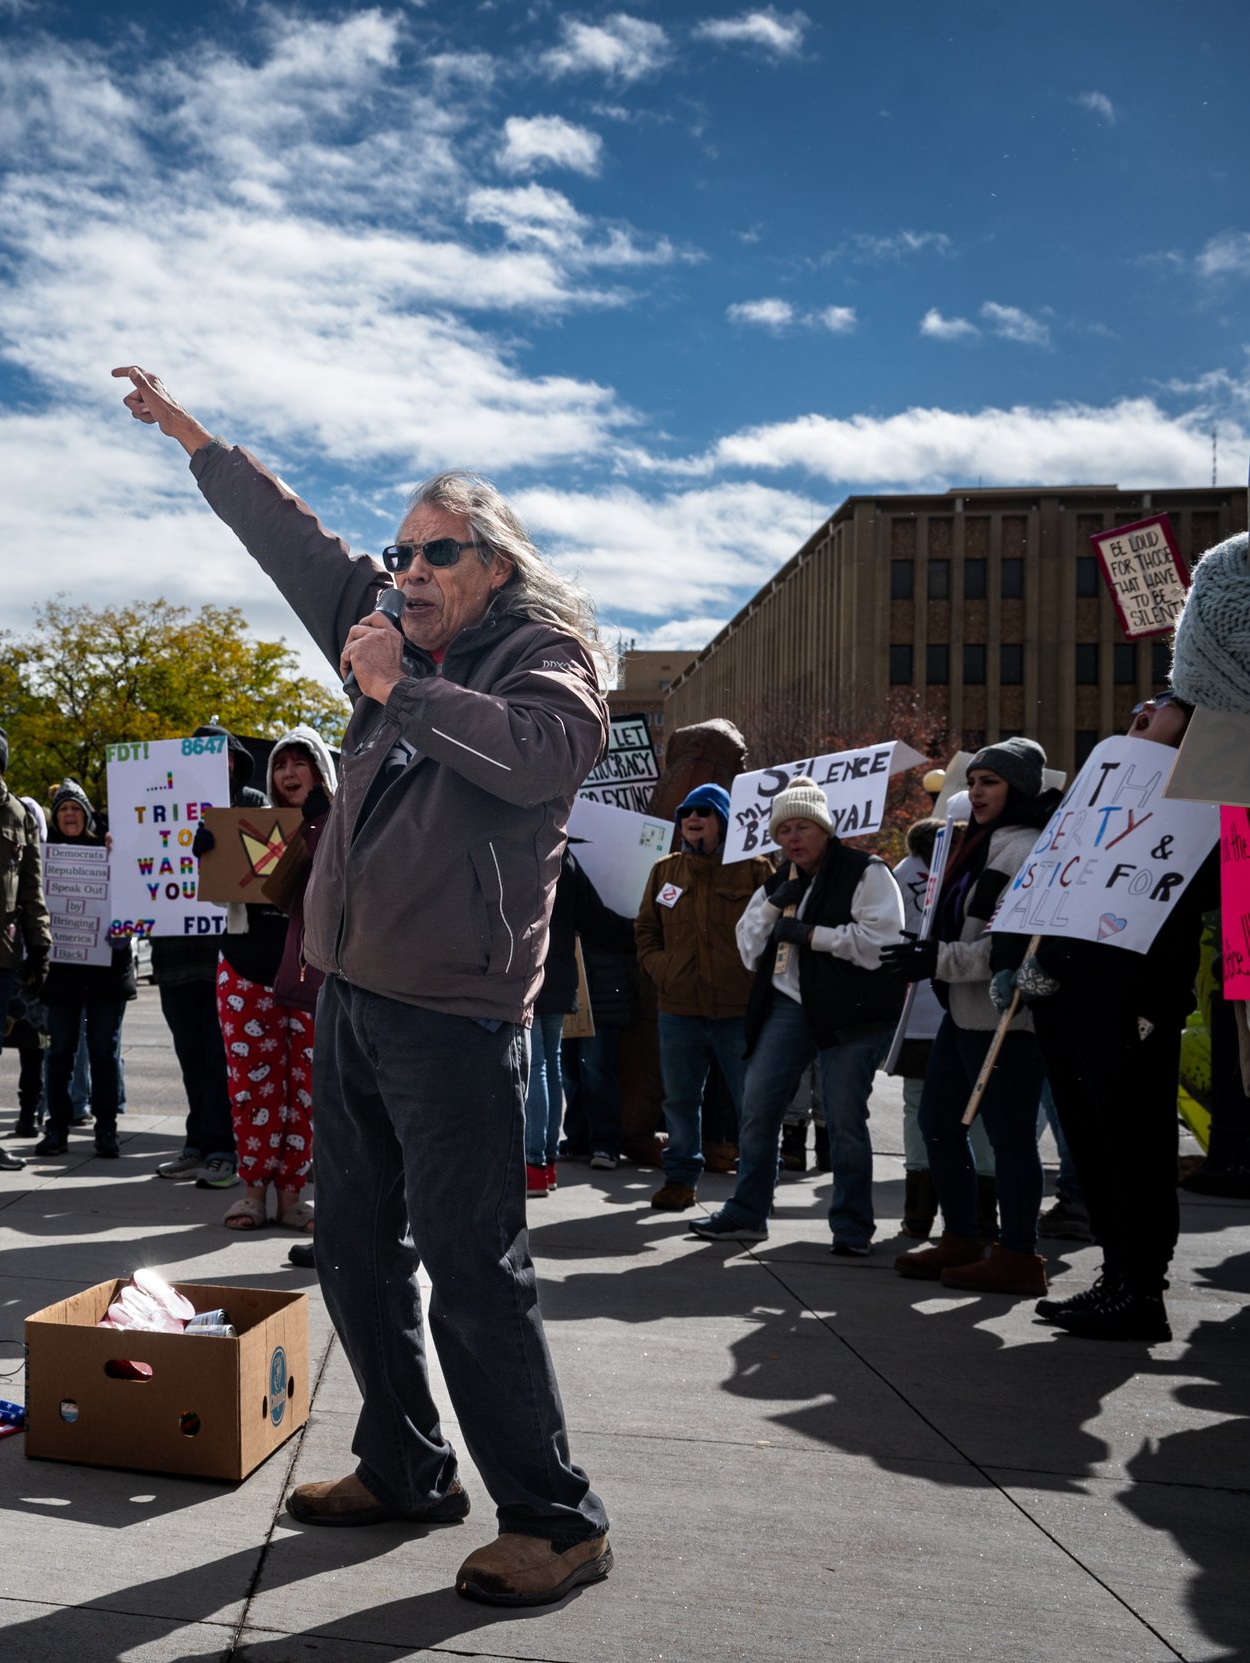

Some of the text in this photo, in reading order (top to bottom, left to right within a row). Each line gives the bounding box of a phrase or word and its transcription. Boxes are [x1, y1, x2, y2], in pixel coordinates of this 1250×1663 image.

[1109, 531, 1159, 558] BE LOUD
[1110, 546, 1174, 578] FOR THOSE
[1112, 567, 1178, 595] THAT HAVE
[1129, 588, 1171, 609] TO BE
[612, 725, 644, 749] LET
[106, 735, 227, 762] FDT! 8647
[159, 829, 193, 848] TO
[1034, 806, 1174, 861] BERTY &
[51, 848, 104, 860] Democrats
[46, 864, 108, 878] Republicans
[137, 856, 201, 876] WAR
[51, 882, 103, 895] Speak Out
[1012, 855, 1185, 903] USTICE FOR
[146, 881, 196, 901] YOU
[69, 901, 82, 913] by
[1002, 886, 1070, 929] ALL
[53, 916, 95, 930] Bringing
[110, 918, 156, 938] 8647
[53, 931, 92, 943] America
[58, 949, 84, 960] Back
